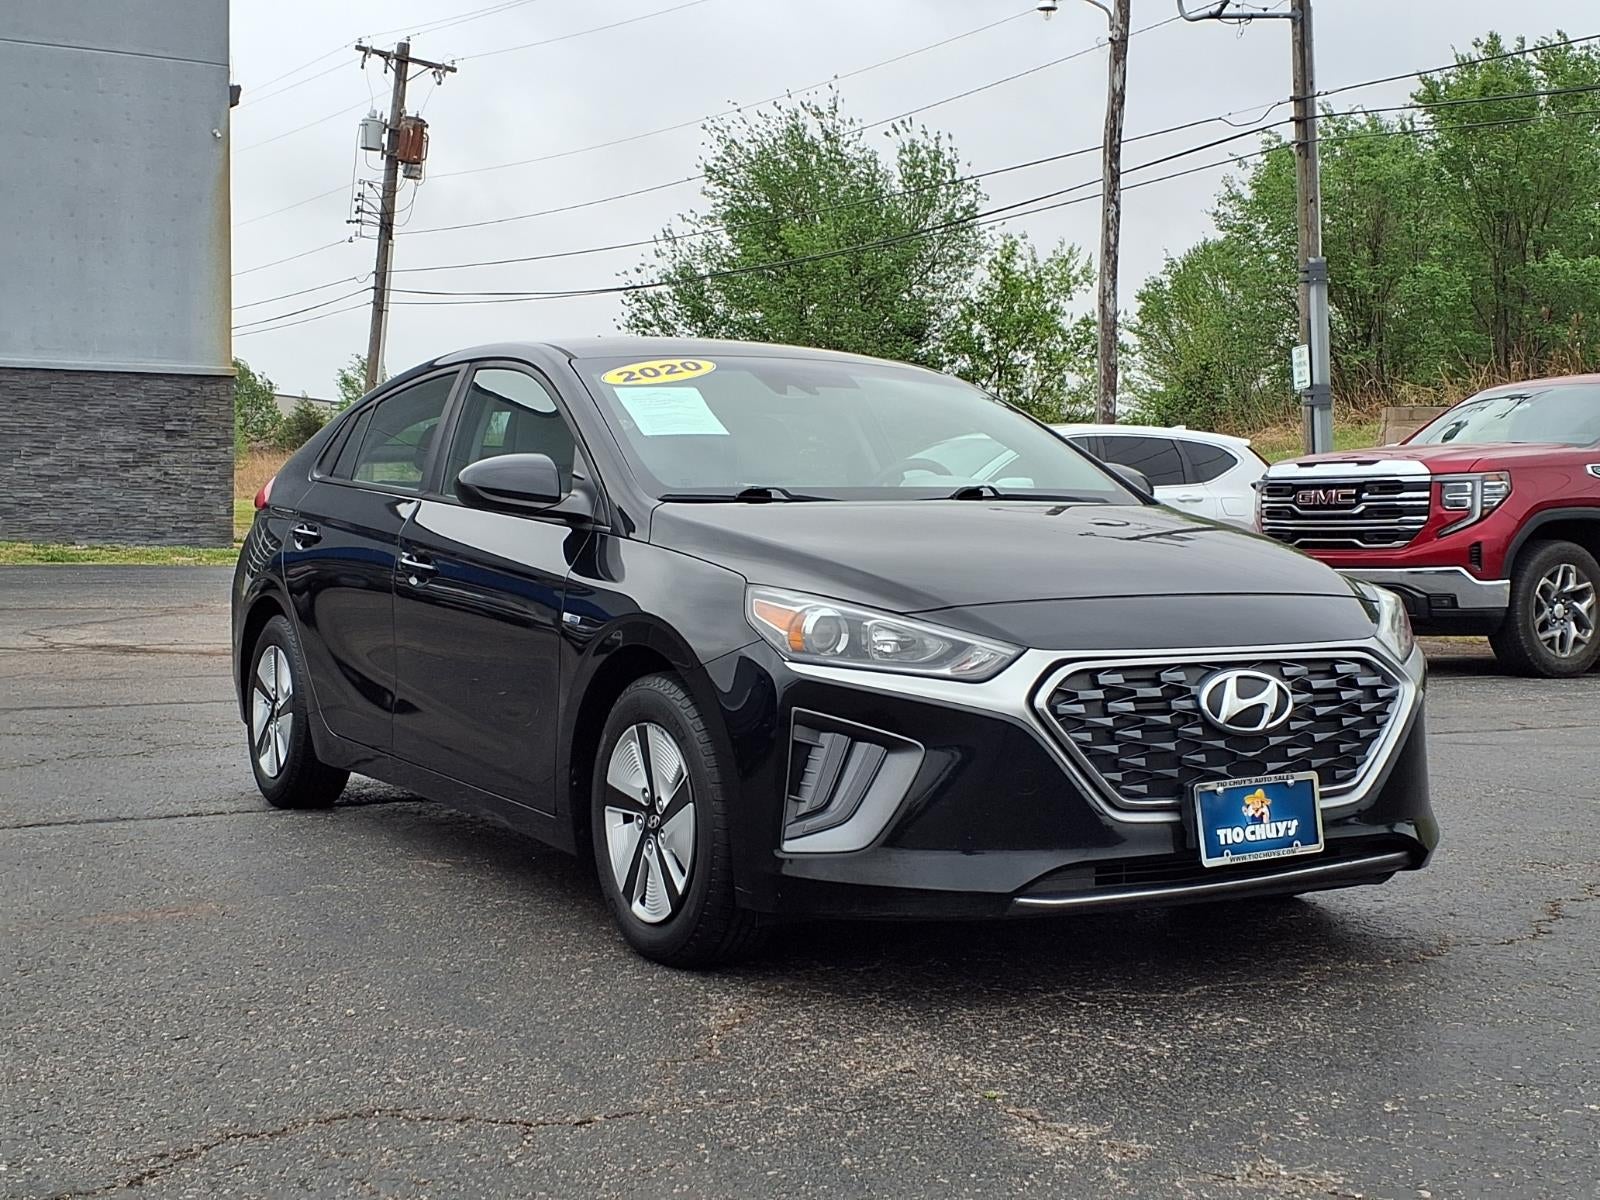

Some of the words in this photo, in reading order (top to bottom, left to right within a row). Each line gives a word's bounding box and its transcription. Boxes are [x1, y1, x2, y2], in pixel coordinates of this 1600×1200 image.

[616, 361, 703, 382] 2020
[1296, 489, 1356, 505] GMC
[1228, 779, 1253, 787] CHUY'S
[1254, 776, 1272, 784] AUTO
[1273, 774, 1295, 782] SALES
[1229, 848, 1297, 863] WWW.TIOCHUYS.COM
